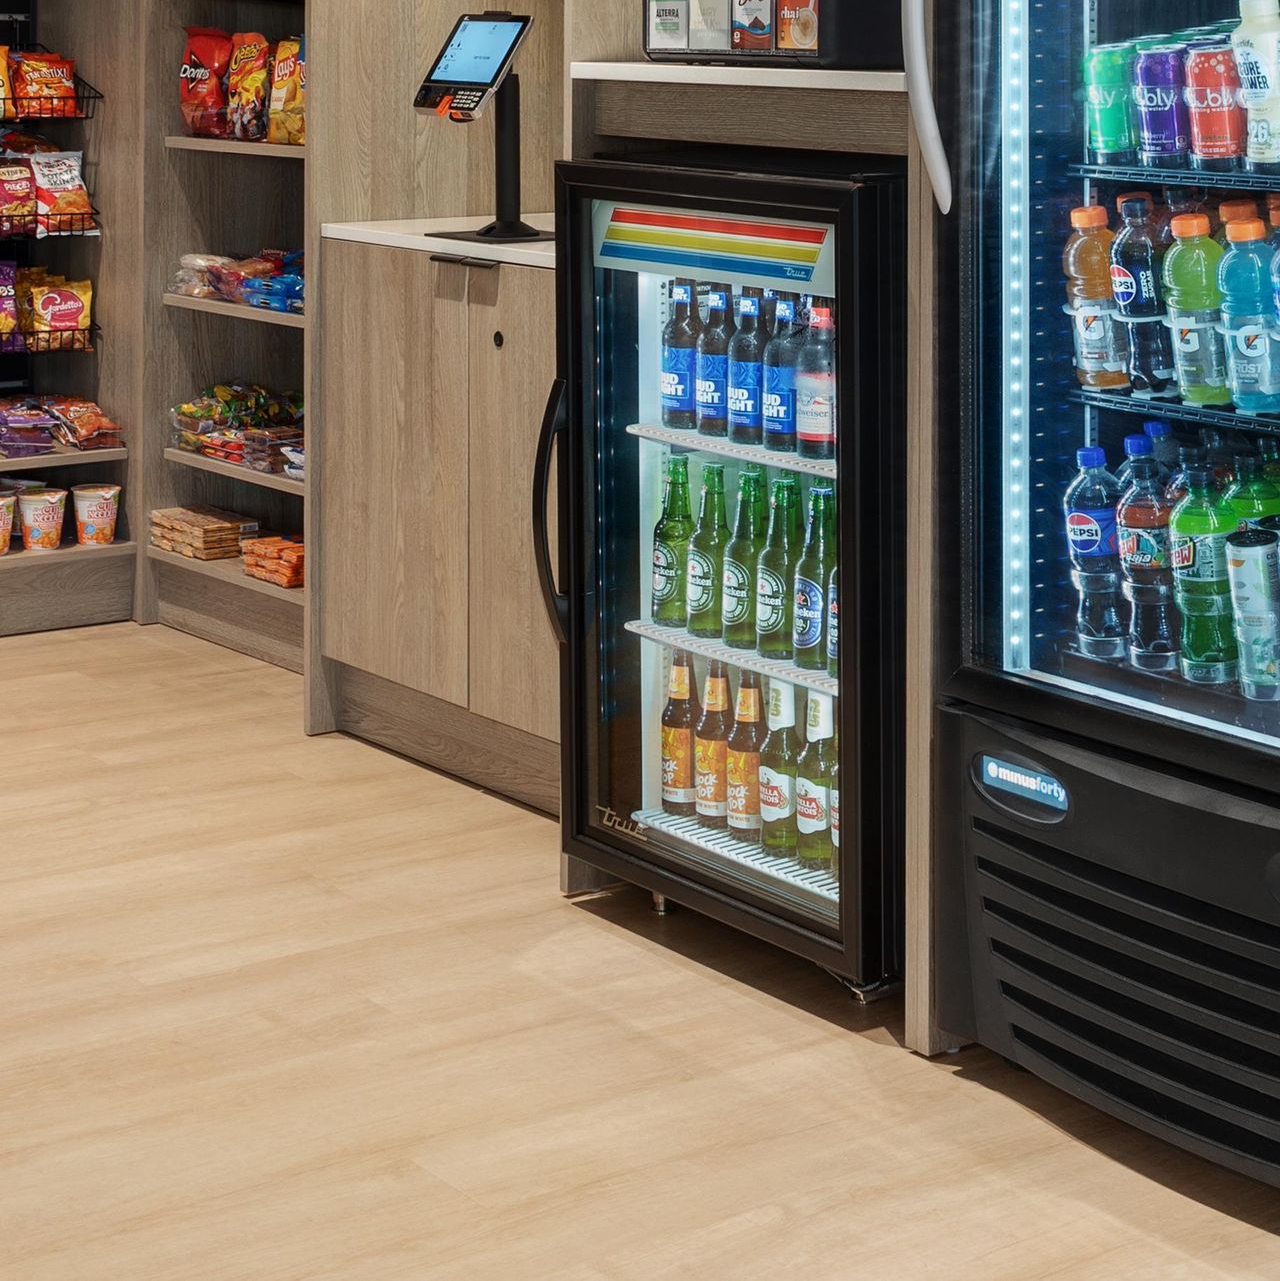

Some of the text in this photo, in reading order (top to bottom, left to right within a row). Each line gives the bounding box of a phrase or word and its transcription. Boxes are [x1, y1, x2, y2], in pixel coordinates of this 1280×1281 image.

[656, 8, 679, 19] ALTERRA
[781, 7, 801, 19] chai
[180, 64, 211, 80] Doritos
[274, 55, 295, 81] Lay's
[4, 181, 30, 190] PIECES
[1068, 528, 1099, 539] PEPSI
[999, 766, 1065, 802] minusforty
